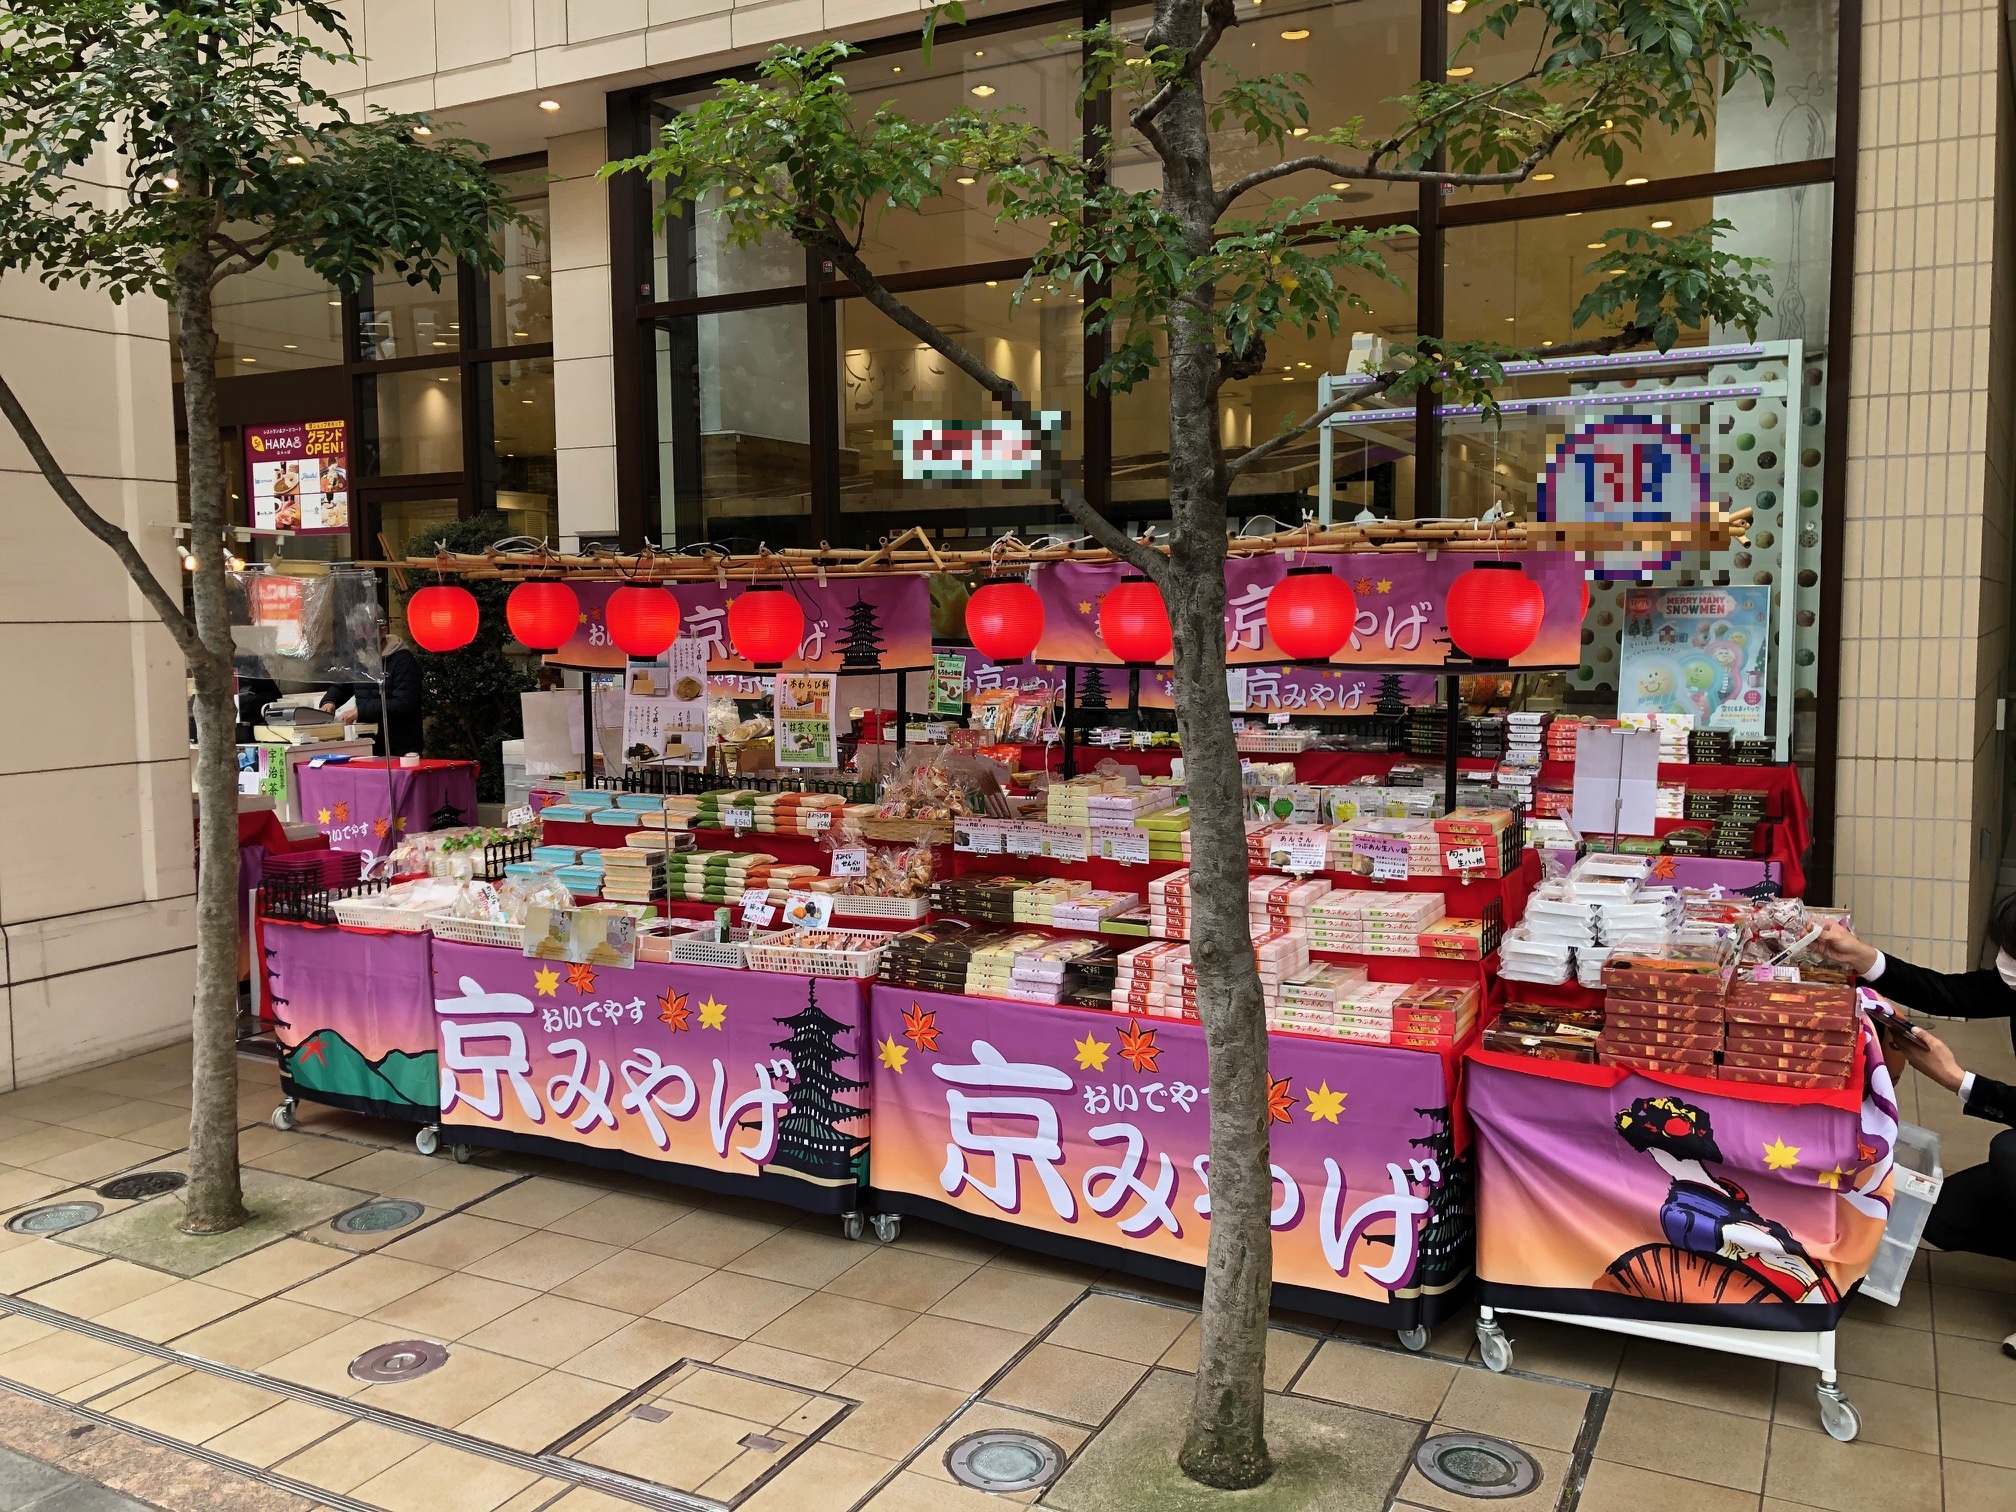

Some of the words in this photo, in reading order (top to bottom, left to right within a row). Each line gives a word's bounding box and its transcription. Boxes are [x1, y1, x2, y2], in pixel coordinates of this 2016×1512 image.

[307, 429, 343, 443] グランド
[305, 441, 344, 456] OPEN!
[1666, 597, 1698, 605] MERRY
[1699, 597, 1725, 605] MANY
[1666, 605, 1725, 615] SNOWMEN
[789, 679, 830, 690] 本わらび餅
[1247, 669, 1366, 711] 京みやげ
[268, 749, 279, 796] 宇治茶
[1355, 843, 1408, 854] つぶあん生八ッ橋
[541, 996, 646, 1033] おいでやす
[434, 975, 797, 1163] 京みやげ
[1083, 1080, 1210, 1115] おいでや
